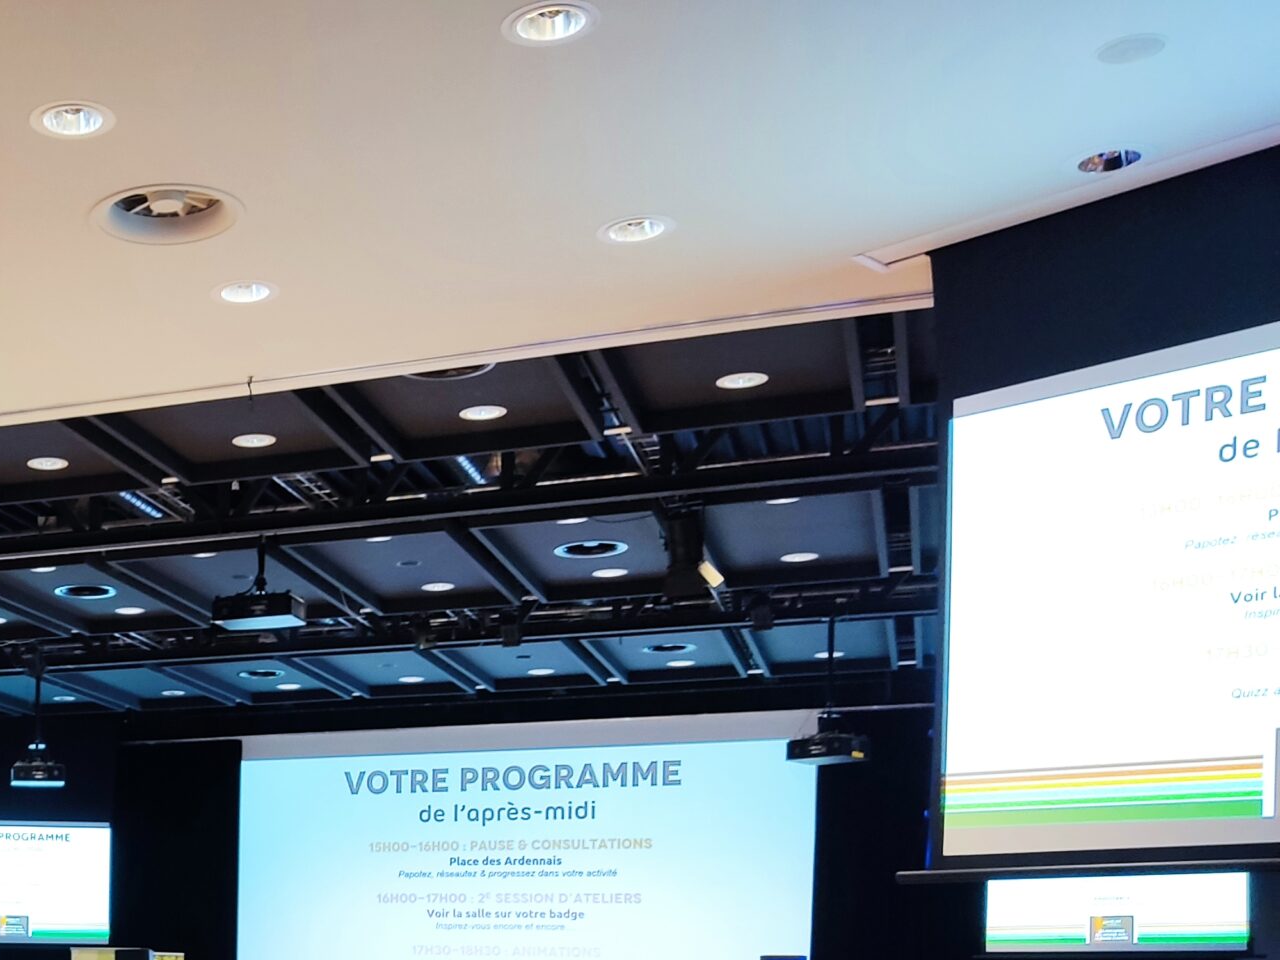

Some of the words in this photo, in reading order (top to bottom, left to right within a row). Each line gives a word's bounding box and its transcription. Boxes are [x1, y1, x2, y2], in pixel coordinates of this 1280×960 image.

[1100, 375, 1267, 440] VOTRE
[1218, 435, 1260, 463] de
[1229, 588, 1267, 604] Voir
[345, 767, 450, 795] VOTRE
[460, 760, 683, 793] PROGRAMME
[418, 804, 446, 823] de
[453, 801, 597, 826] l'après-midi
[368, 840, 460, 853] 15H00-16H00
[470, 840, 515, 851] PAUSE
[518, 840, 528, 850] &
[531, 838, 653, 851] CONSULTATIONS
[449, 856, 480, 867] Place
[482, 856, 502, 867] des
[504, 855, 563, 867] Ardennais
[487, 870, 537, 880] progressez
[538, 869, 560, 878] dans
[562, 869, 584, 878] votre
[586, 868, 619, 878] activité
[376, 893, 468, 905] 16H00-17H00
[495, 893, 555, 905] SESSION
[558, 892, 643, 905] D'ATELIERS
[426, 909, 451, 919] Voir
[453, 909, 464, 919] la
[465, 909, 492, 919] salle
[494, 911, 513, 919] sur
[515, 910, 547, 919] votre
[549, 909, 586, 920] badge
[511, 945, 602, 959] ANIMATIONS
